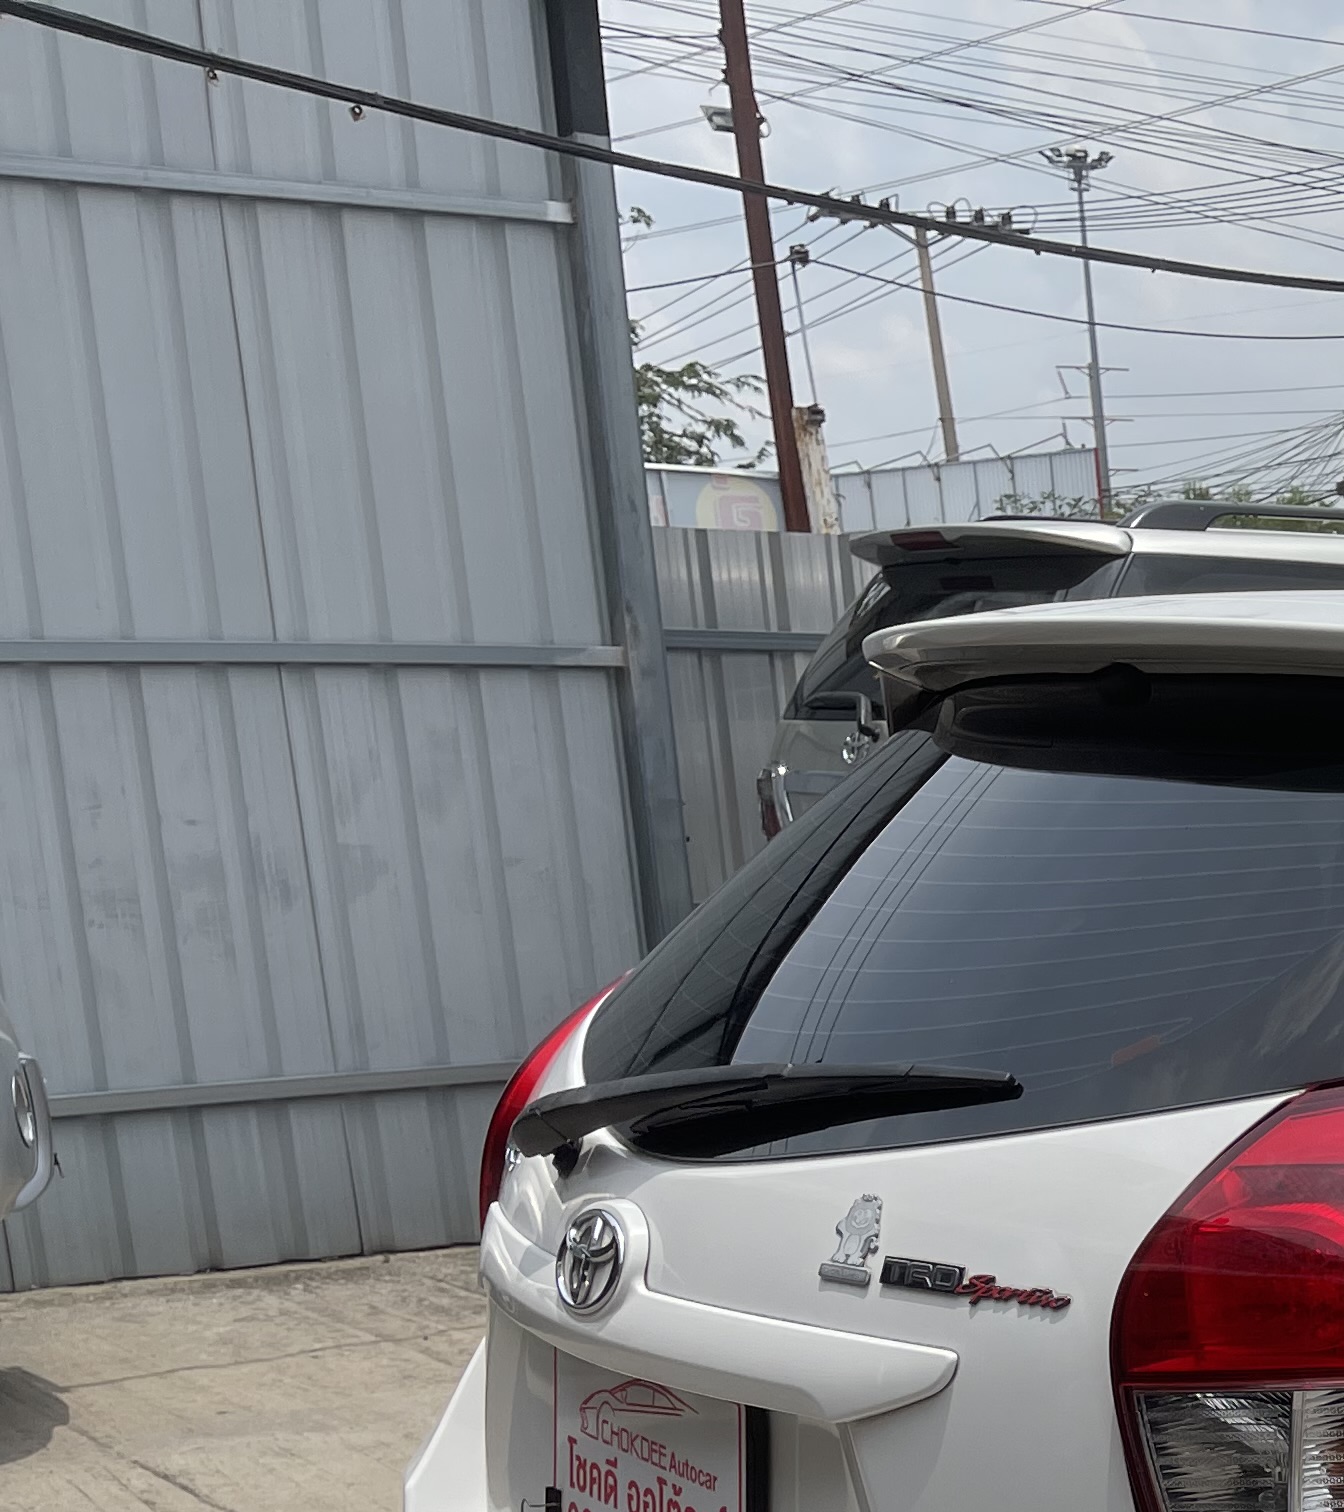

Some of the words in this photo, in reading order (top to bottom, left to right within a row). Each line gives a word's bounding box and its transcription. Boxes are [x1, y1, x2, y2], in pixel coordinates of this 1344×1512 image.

[884, 1256, 960, 1291] TRD
[567, 1434, 618, 1510] โชคดี
[600, 1419, 667, 1471] CHOKDEE
[668, 1451, 718, 1493] Autocar
